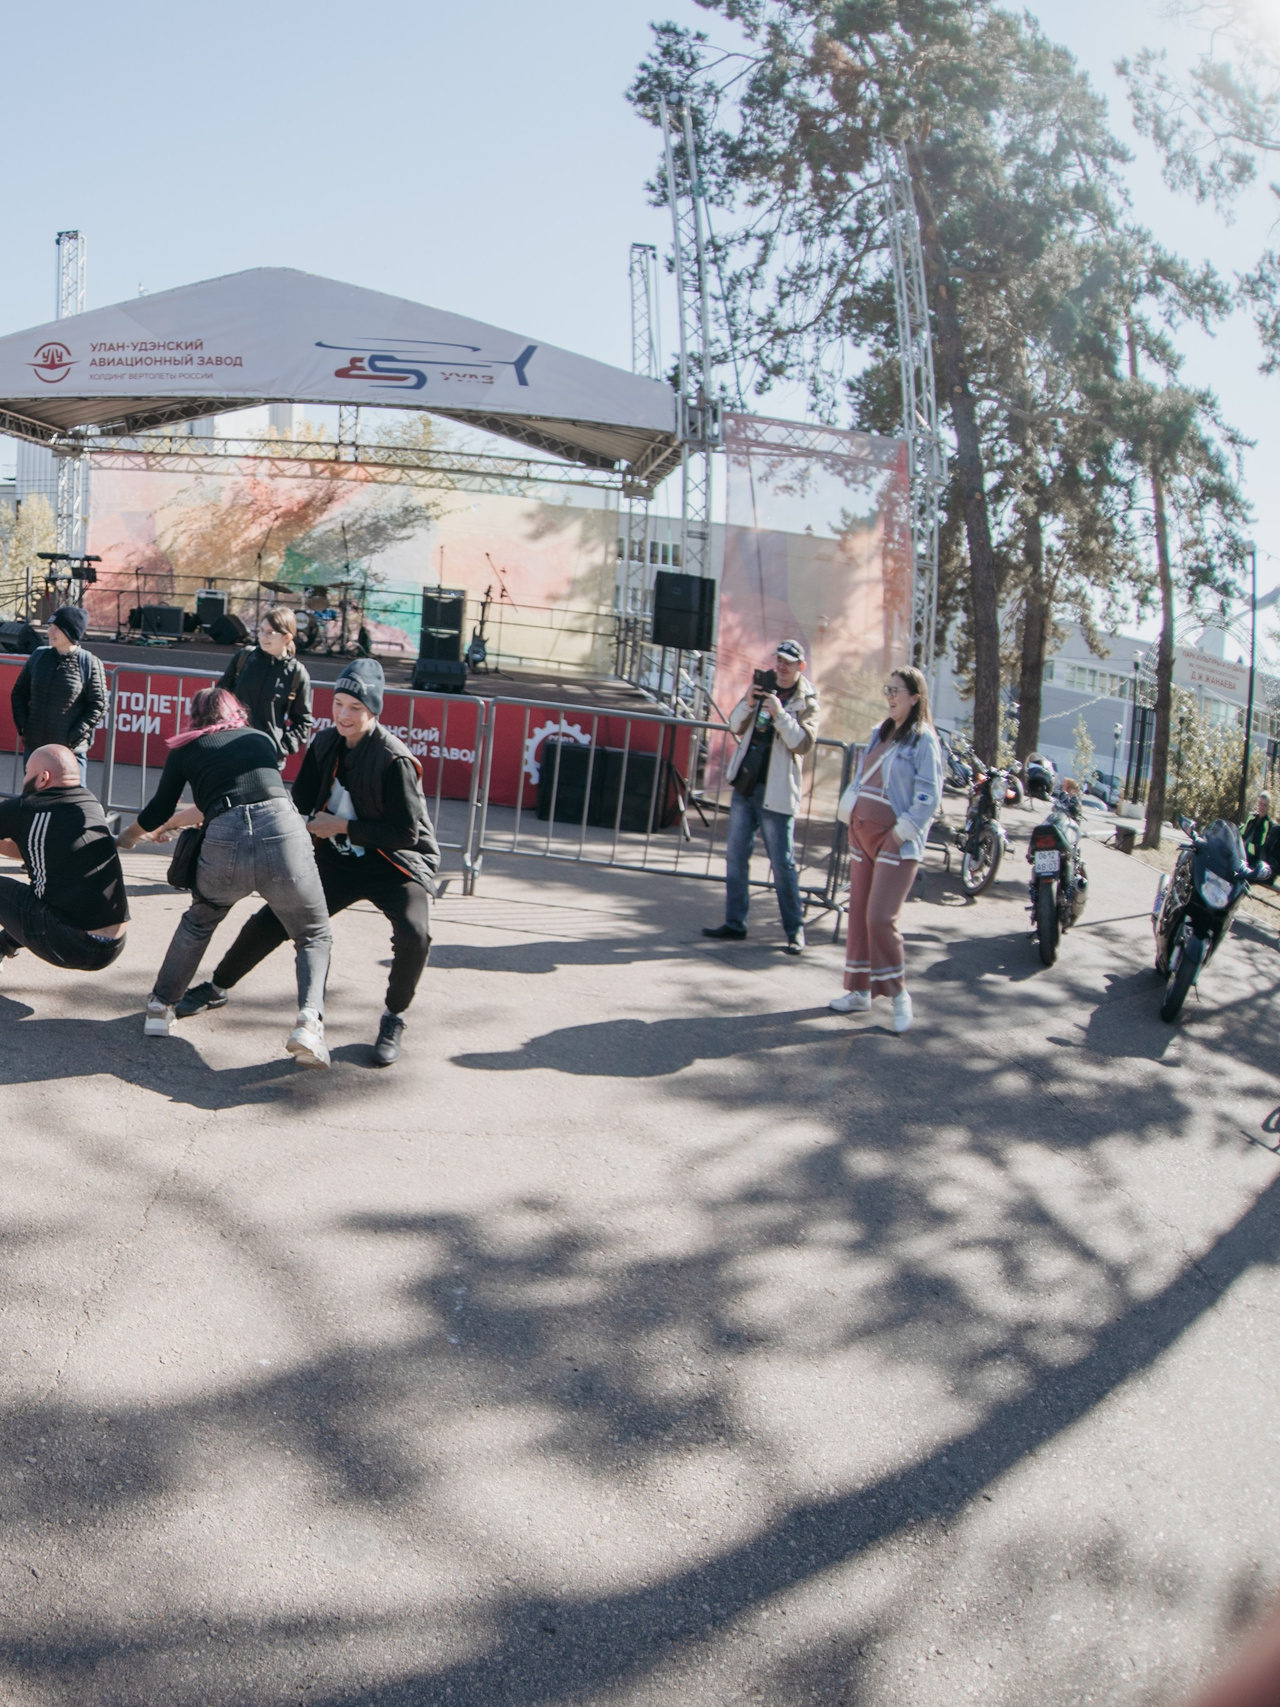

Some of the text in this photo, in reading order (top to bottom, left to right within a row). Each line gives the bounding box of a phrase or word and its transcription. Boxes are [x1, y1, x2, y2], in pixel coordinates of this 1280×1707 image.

[90, 339, 204, 352] УЛАН-УДЭНСКИЙ
[89, 354, 243, 368] АВИАЦИОННЫЙ ЗАВОД
[88, 372, 214, 381] ХОЛДИНГ ВЕРТОЛЕТЫ РОССИИ
